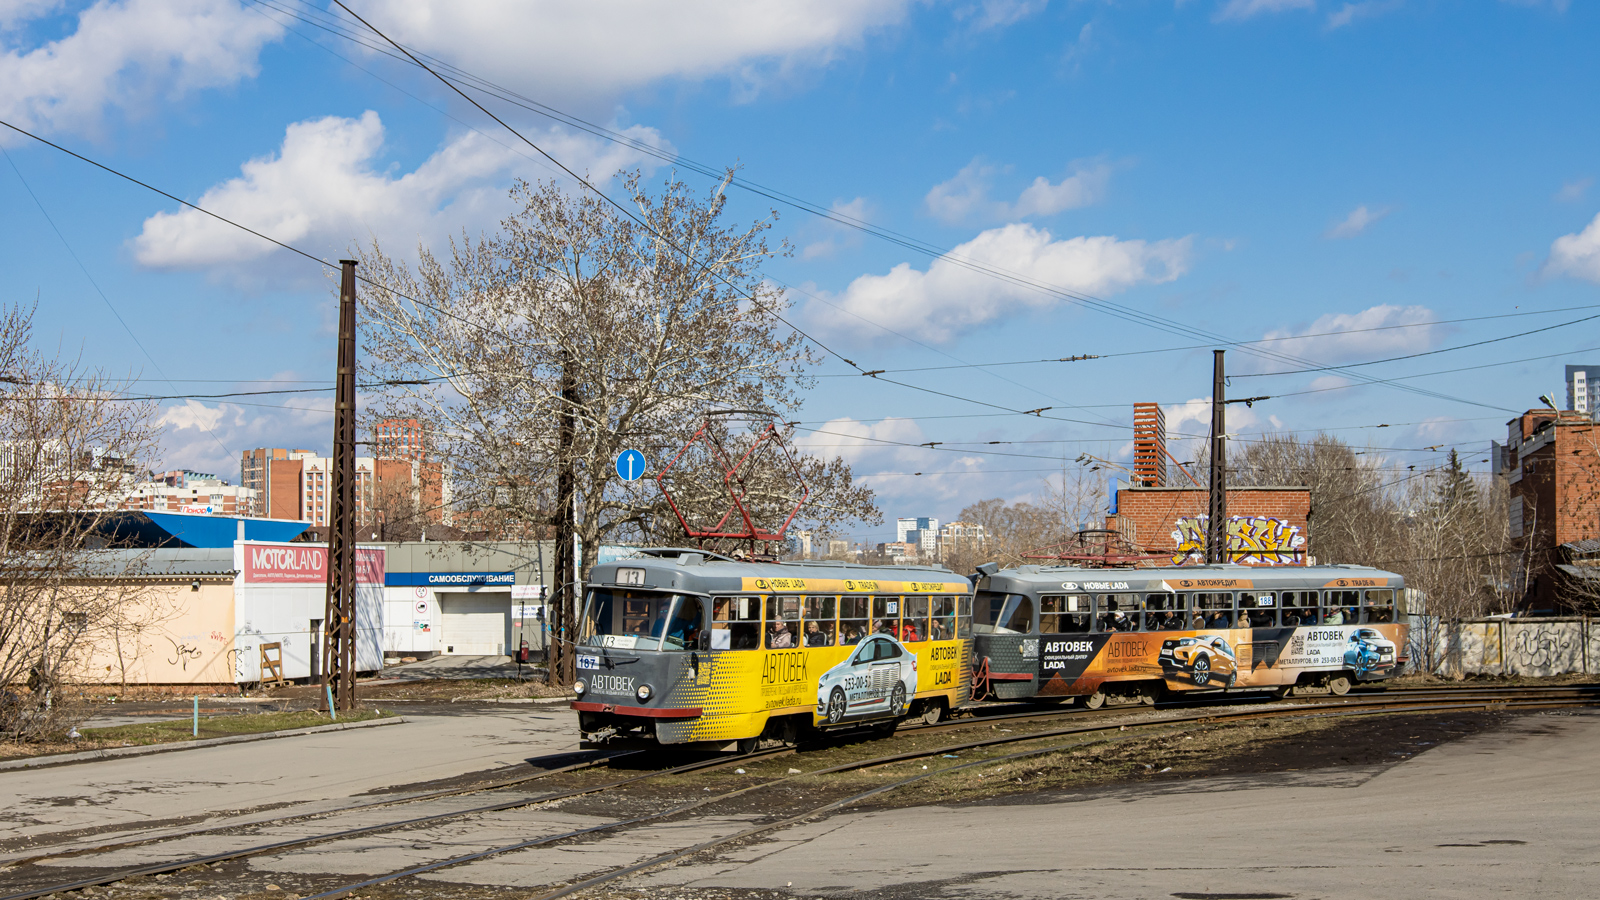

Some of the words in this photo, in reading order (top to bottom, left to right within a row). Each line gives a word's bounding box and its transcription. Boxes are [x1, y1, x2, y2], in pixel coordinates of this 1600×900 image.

[252, 548, 322, 570] MOTORLAND
[428, 574, 514, 583] САМООБСЛУЖИВАНИЕ
[625, 571, 639, 585] 13
[1197, 579, 1238, 587] АВТОКРЕДИТ
[1084, 582, 1110, 590] НОВЫЕ
[1260, 597, 1272, 605] 188
[606, 636, 616, 647] 13
[1307, 631, 1344, 641] АВТОВЕК
[1044, 641, 1093, 652] АВТОВЕК
[1107, 641, 1148, 657] АВТОВЕК
[580, 658, 595, 668] 187
[761, 651, 809, 684] АВТОВЕК
[1043, 661, 1065, 669] LADA
[591, 674, 635, 691] АВТОВЕК
[935, 671, 951, 685] LADA
